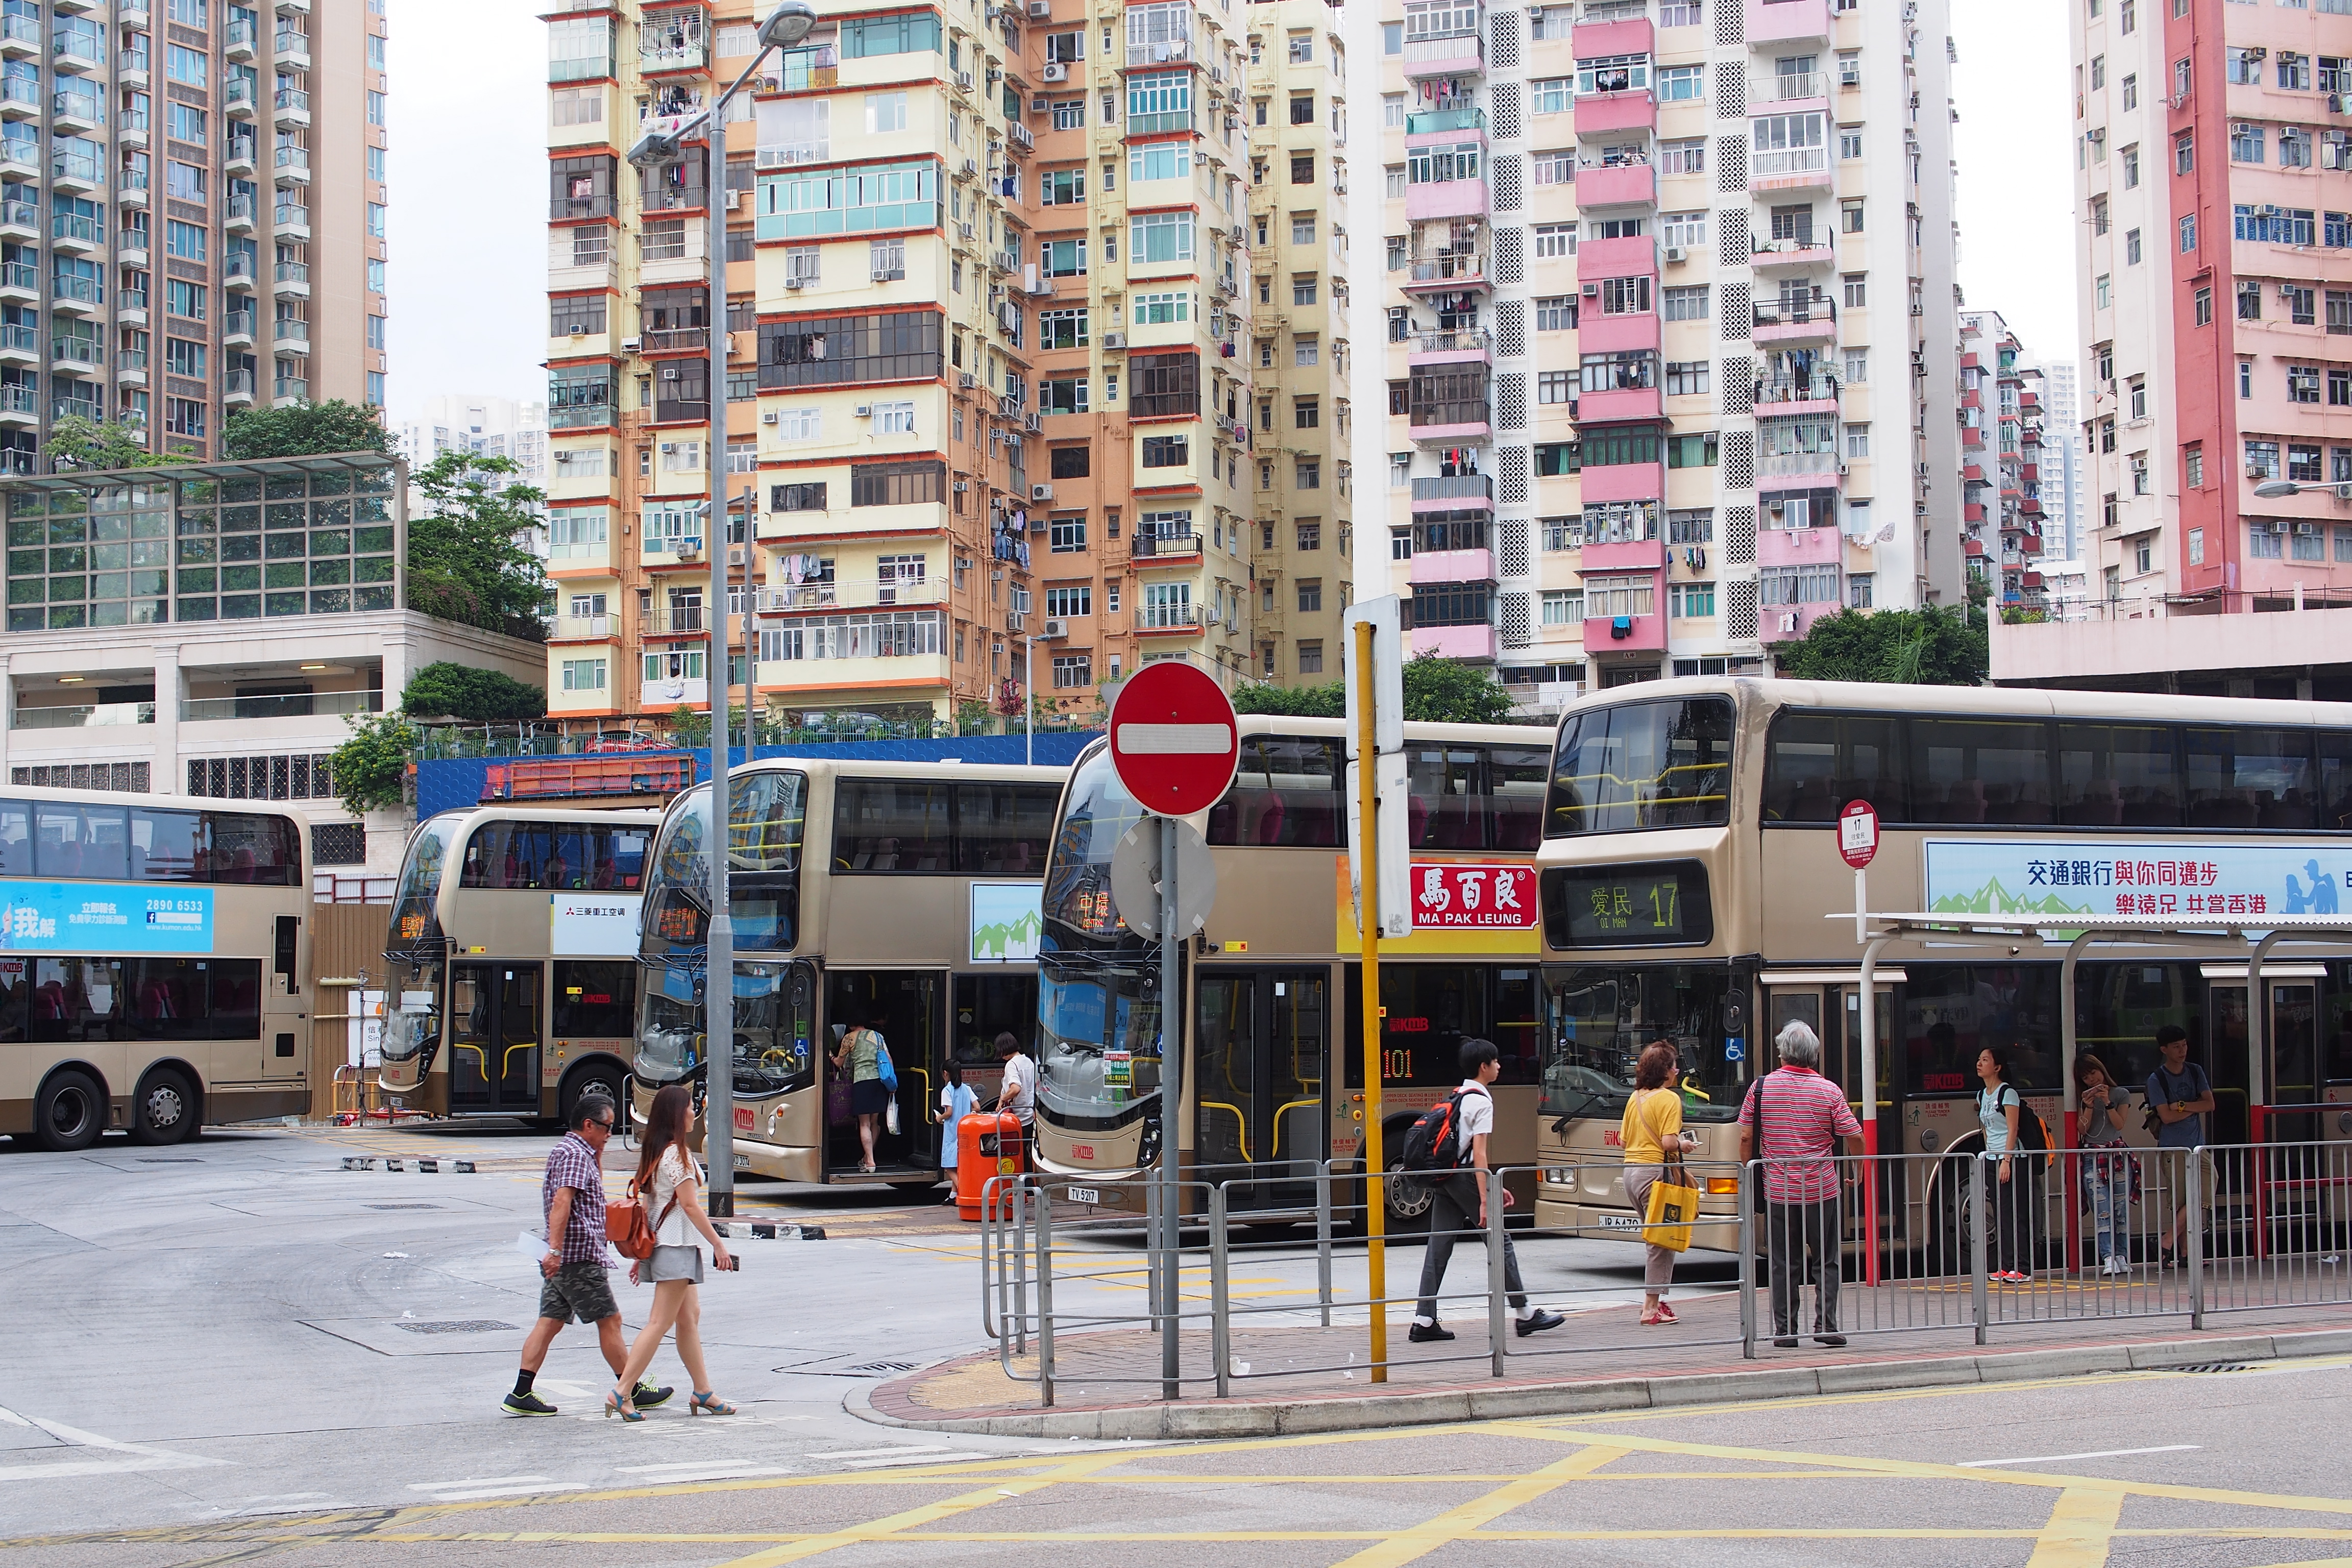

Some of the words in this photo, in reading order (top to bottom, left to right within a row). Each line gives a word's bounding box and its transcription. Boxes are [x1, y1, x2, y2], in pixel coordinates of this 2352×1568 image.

[1854, 819, 1860, 830] 17
[1419, 868, 1522, 912] 馬百良
[82, 902, 117, 914] 立即報名
[146, 900, 173, 910] 2890
[177, 900, 203, 911] 6533
[1080, 892, 1109, 918] 中環
[1591, 886, 1632, 916] 愛民
[1649, 883, 1678, 926] 17
[576, 907, 625, 916] 三菱重工空调
[1419, 913, 1440, 923] MA
[1445, 913, 1473, 923] PAK
[1478, 913, 1522, 924] LEUNG
[1600, 918, 1608, 928] OI
[1612, 917, 1627, 928] MAN
[3, 962, 23, 973] KMB
[1401, 1017, 1429, 1032] KMB
[1383, 1049, 1412, 1077] 101
[1936, 1073, 1964, 1089] KMB
[735, 1108, 754, 1131] KMB
[1078, 1145, 1094, 1160] KMB
[740, 1157, 750, 1166] 3074
[1072, 1189, 1080, 1200] TV
[1081, 1190, 1094, 1202] 5217
